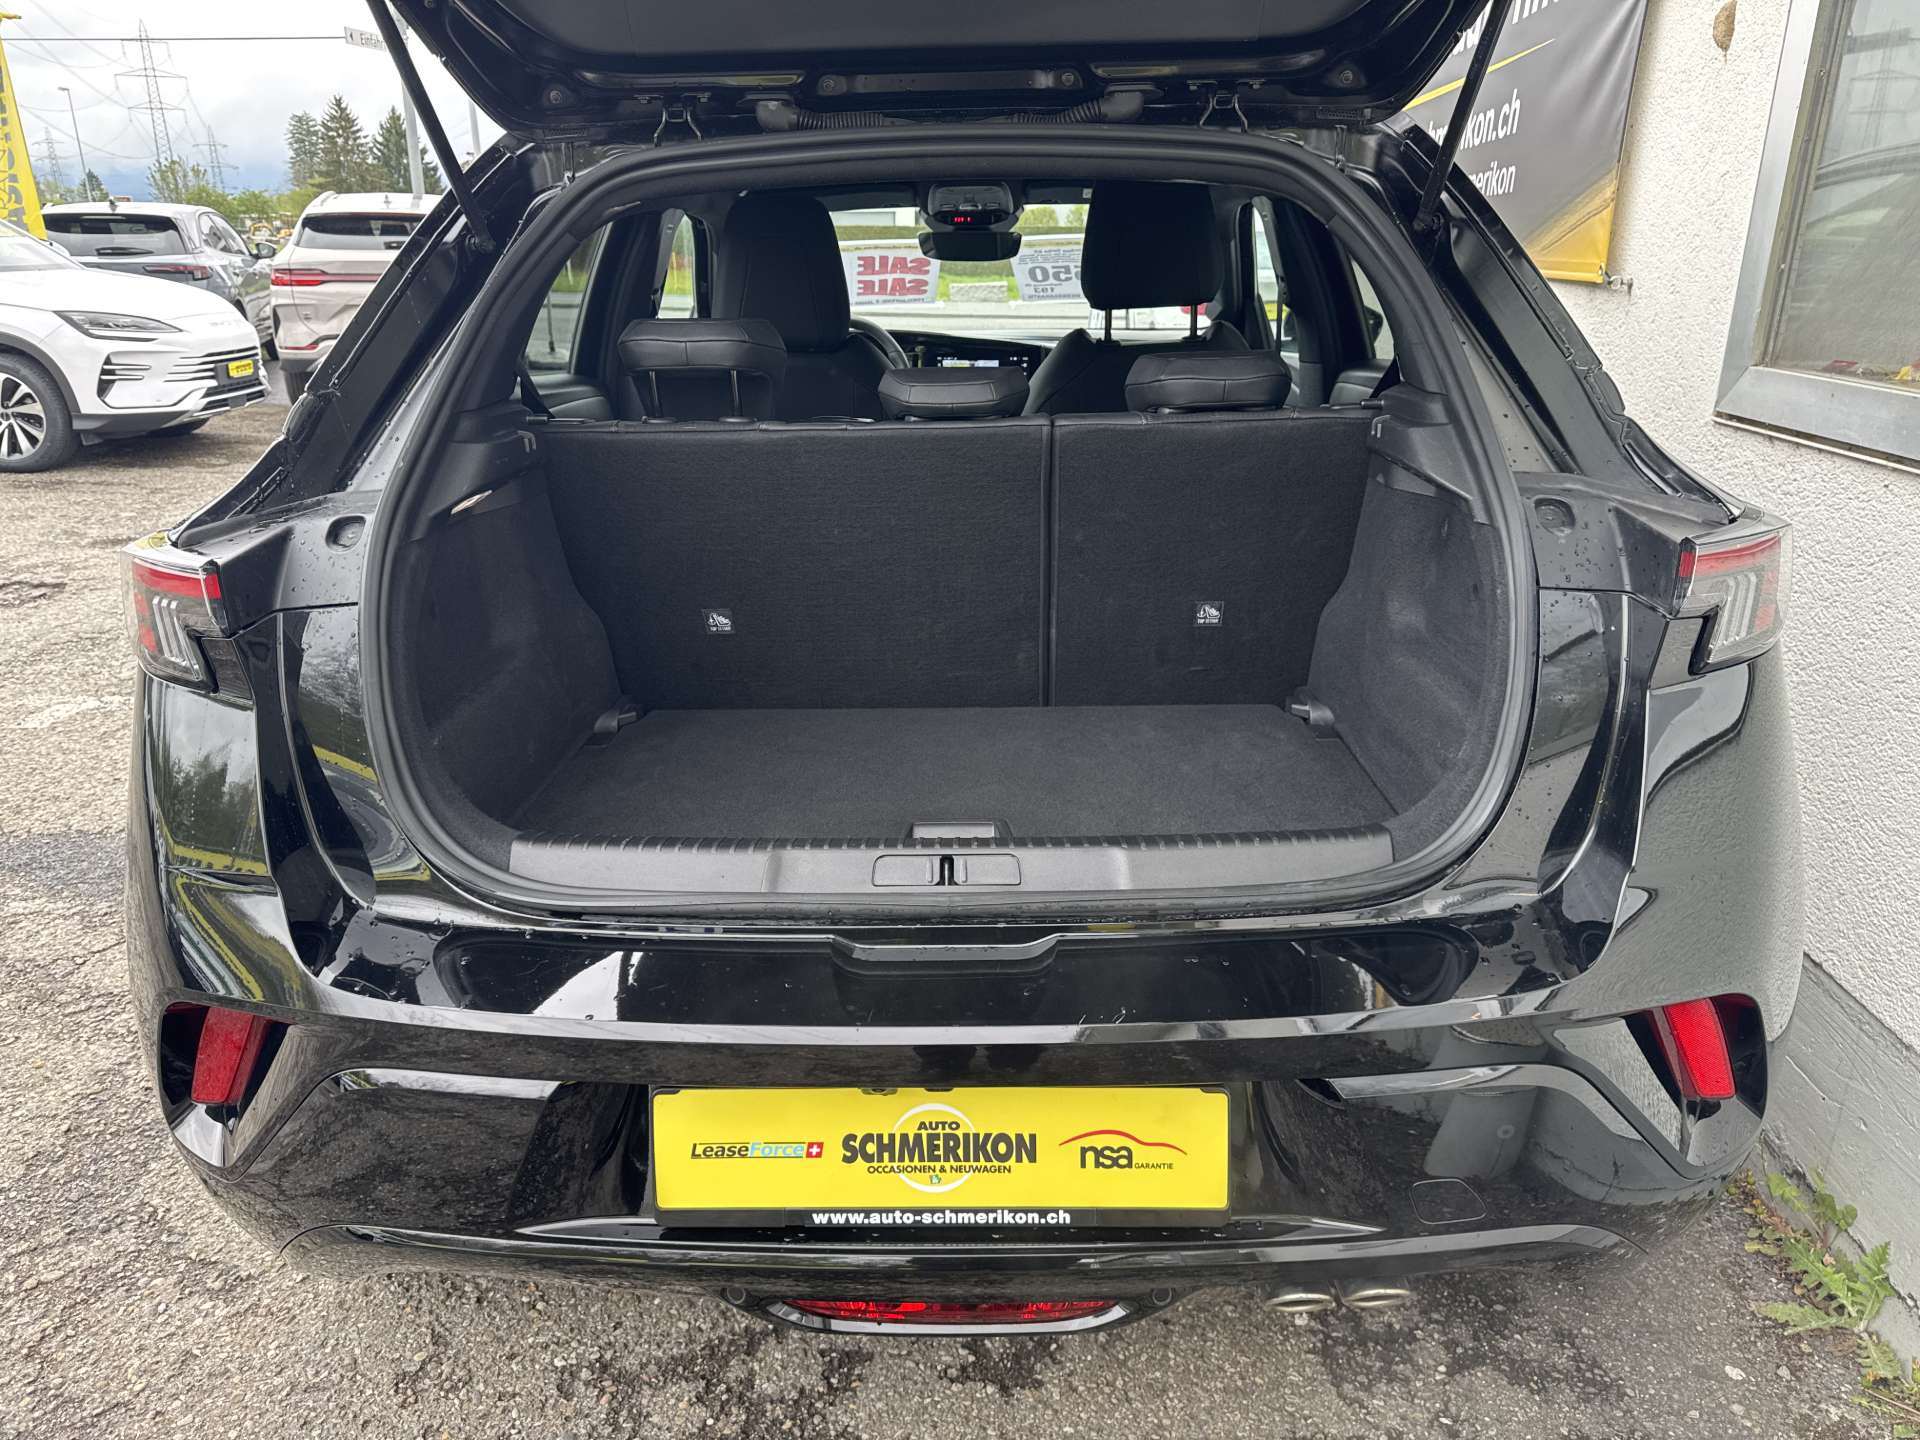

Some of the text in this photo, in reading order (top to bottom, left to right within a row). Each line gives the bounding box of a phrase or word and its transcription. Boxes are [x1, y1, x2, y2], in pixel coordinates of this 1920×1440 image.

[917, 1121, 960, 1131] AUTO
[691, 1142, 805, 1159] LeaseForce
[841, 1132, 1037, 1164] SCHMERIKON
[1080, 1146, 1174, 1170] nsa GARANTIE
[867, 1164, 1011, 1174] OCCASIONEN & NEUWAGEN
[812, 1209, 1071, 1224] www.auto-schmerikon.ch
